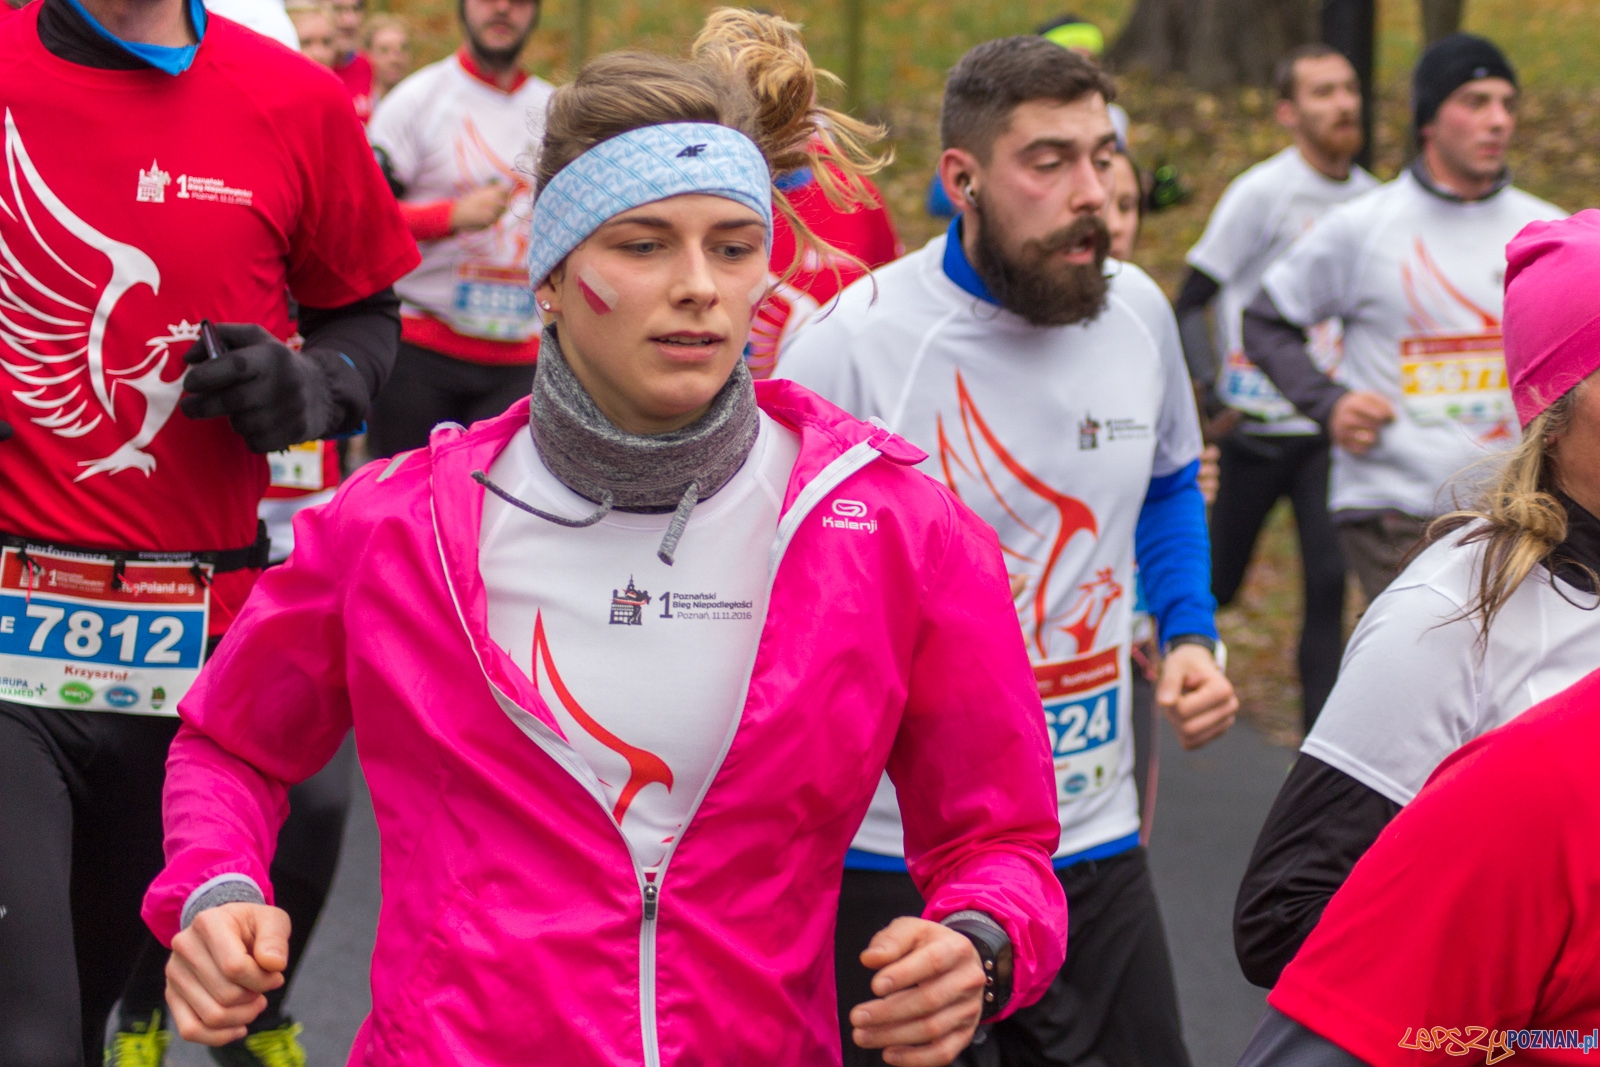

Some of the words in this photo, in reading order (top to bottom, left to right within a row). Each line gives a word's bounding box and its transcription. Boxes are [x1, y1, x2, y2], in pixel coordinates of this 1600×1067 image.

[176, 174, 190, 199] 1
[822, 516, 878, 534] Kalenji
[673, 592, 717, 600] Poznański
[659, 592, 673, 619] 1
[673, 601, 691, 609] Bieg
[692, 601, 753, 609] Niepodległości
[712, 611, 752, 620] 11.11.2016
[0, 615, 15, 634] E
[26, 603, 184, 664] 7812
[65, 665, 128, 681] Krzysztof
[0, 686, 34, 699] UXMED
